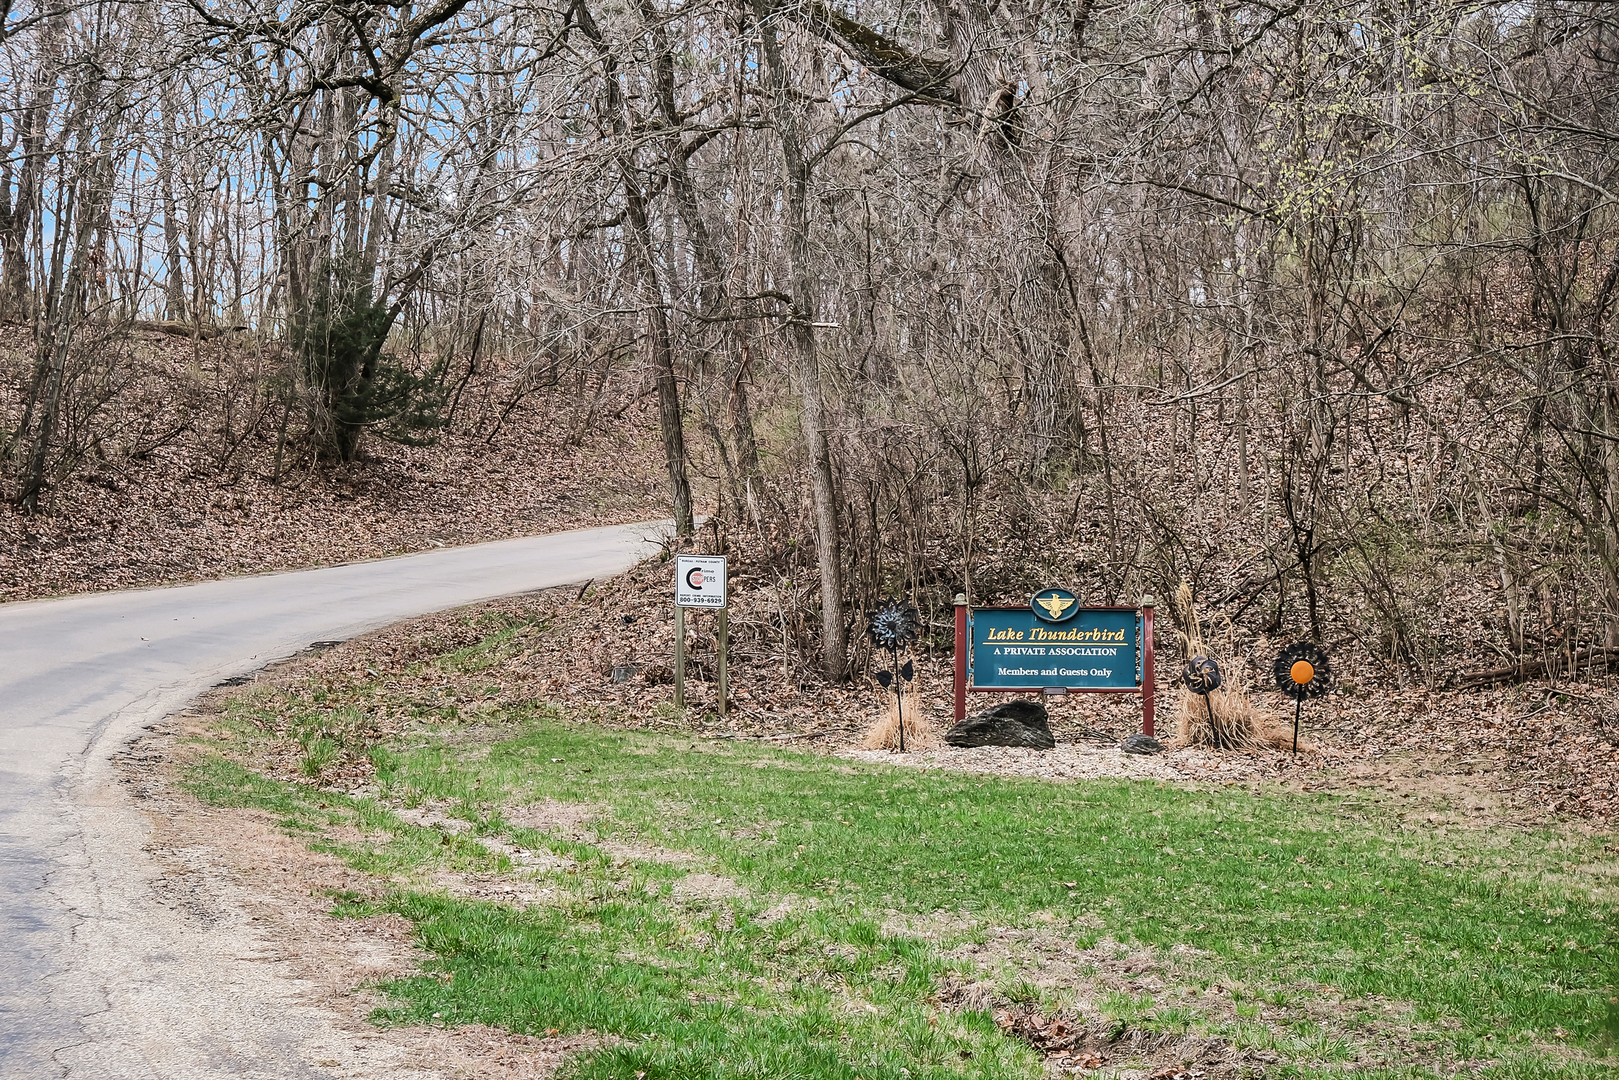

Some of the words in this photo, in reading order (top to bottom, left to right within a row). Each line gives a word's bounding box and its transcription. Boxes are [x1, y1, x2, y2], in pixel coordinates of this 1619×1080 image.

[988, 628, 1024, 641] Lake
[1028, 628, 1126, 642] Thunderbird
[994, 648, 1001, 656] A
[1004, 648, 1046, 656] PRIVATE
[1048, 648, 1118, 656] ASSOCIATION
[998, 668, 1038, 676] Members
[1040, 668, 1058, 676] and
[1090, 668, 1112, 678] Only
